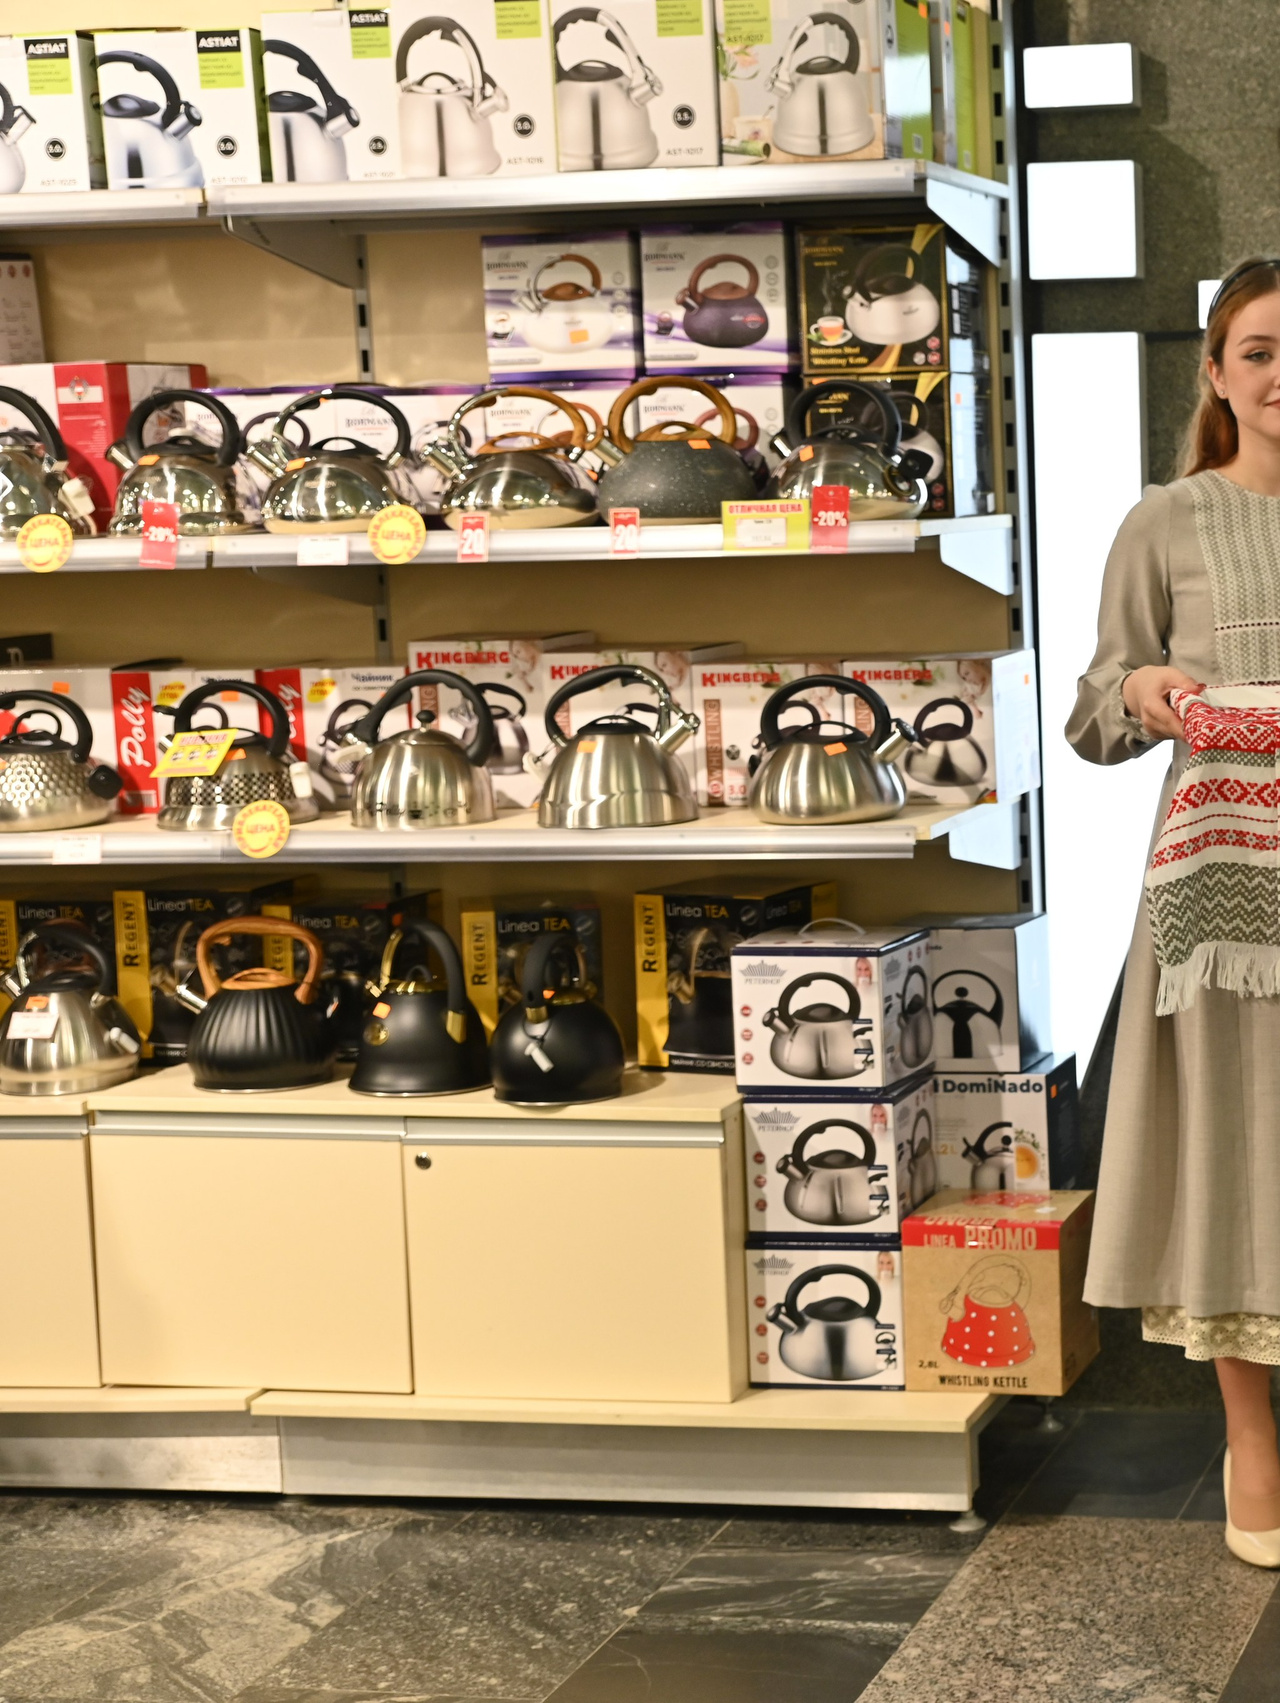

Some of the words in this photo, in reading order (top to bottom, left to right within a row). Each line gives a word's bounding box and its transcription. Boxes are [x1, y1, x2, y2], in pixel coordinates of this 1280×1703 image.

[351, 13, 387, 23] ASTIAT
[27, 43, 67, 54] ASTIAT
[199, 36, 239, 48] ASTIAT
[729, 504, 777, 514] ОТЛИЧНАЯ
[780, 504, 803, 514] ЦЕНА
[813, 511, 848, 527] -20%
[417, 652, 510, 669] KINGBERG
[702, 672, 780, 687] KINGBERG
[853, 669, 933, 684] KINGBERG
[119, 687, 151, 767] Polly
[709, 701, 723, 781] WHISTLING
[148, 897, 187, 912] Linea
[189, 895, 214, 911] TEA
[667, 903, 702, 918] Linea
[705, 905, 729, 918] TEA
[19, 907, 57, 920] Linea
[59, 906, 84, 919] TEA
[334, 916, 358, 928] TEA
[499, 919, 540, 933] Linea
[544, 918, 571, 931] TEA
[123, 901, 139, 967] REGENT
[643, 903, 658, 973] REGENT
[472, 923, 488, 986] REGENT
[943, 1079, 1043, 1093] DomiNado
[924, 1234, 956, 1248] LINEA
[965, 1227, 1037, 1250] PROMO
[939, 1375, 990, 1387] WHISTLING
[993, 1376, 1028, 1388] KETTLE
